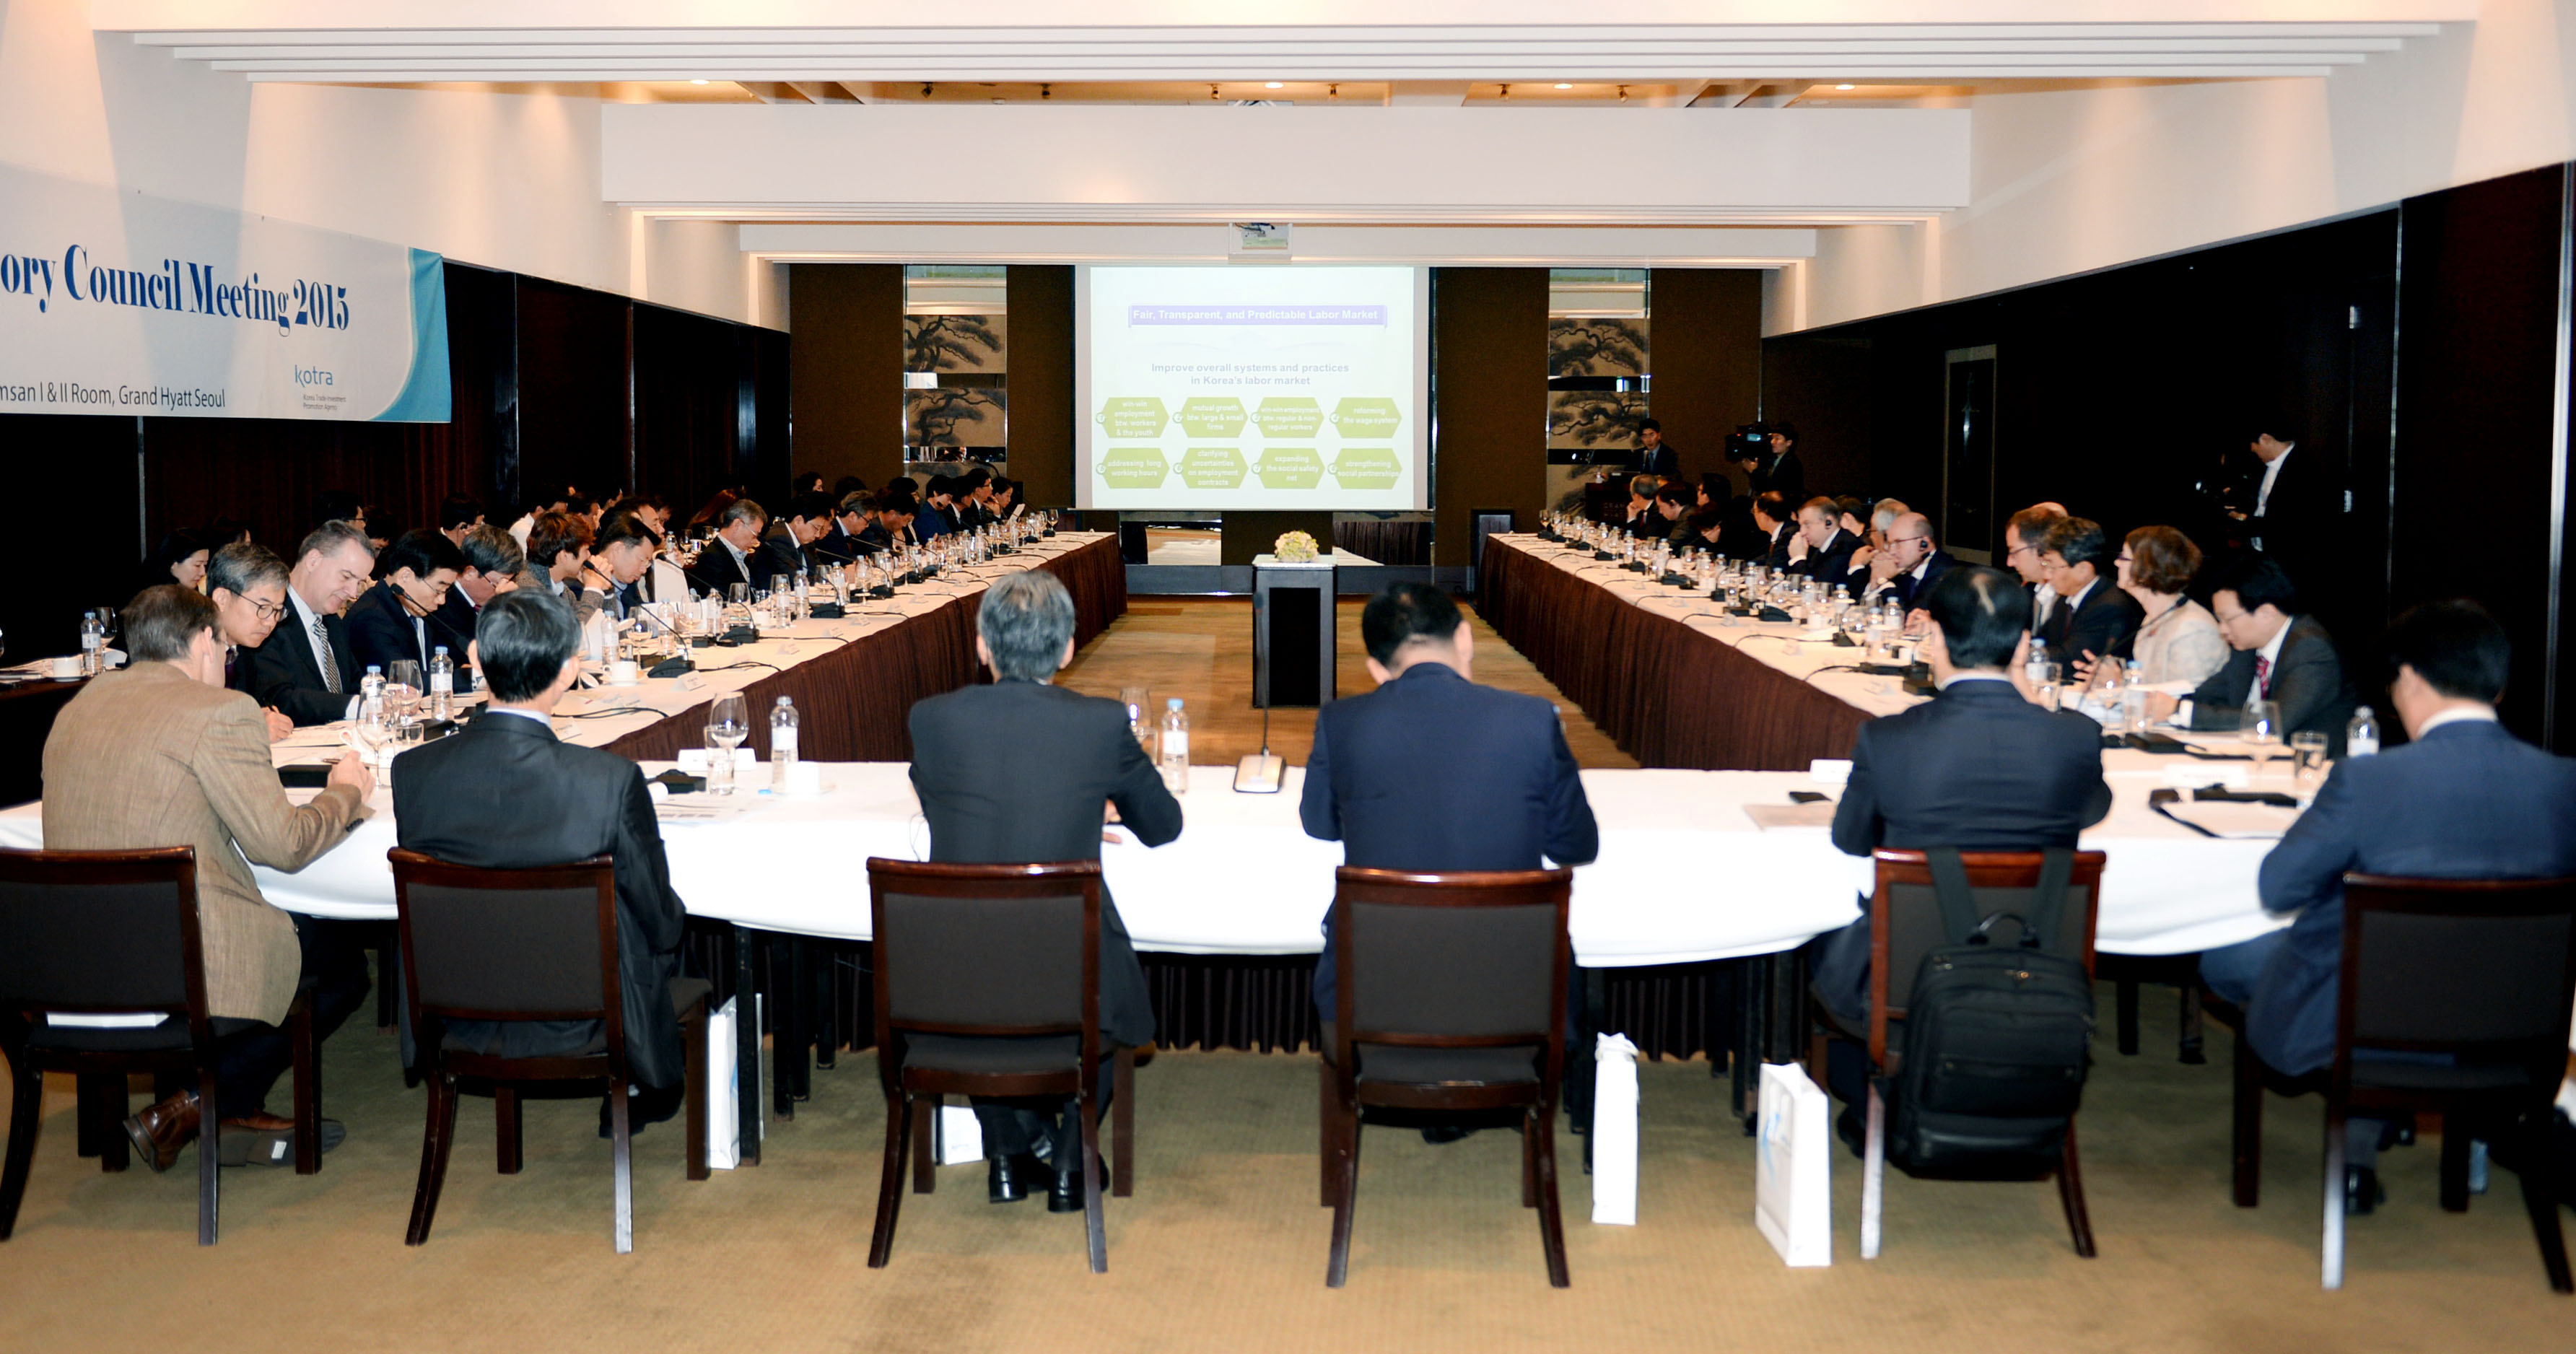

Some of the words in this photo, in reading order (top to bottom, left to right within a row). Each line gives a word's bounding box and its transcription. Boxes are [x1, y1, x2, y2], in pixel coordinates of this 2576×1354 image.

[1, 254, 57, 313] ory
[64, 244, 183, 311] Council
[186, 262, 290, 337] Meeting
[293, 279, 349, 330] 2015
[1133, 310, 1156, 320] Fair,
[1158, 310, 1223, 320] Transparent,
[1226, 310, 1245, 319] and
[1248, 310, 1306, 319] Predictable
[1309, 310, 1340, 319] Labor
[1342, 310, 1379, 319] Market
[1151, 363, 1194, 373] Improve
[1197, 363, 1231, 372] overall
[1234, 364, 1277, 374] systems
[1280, 363, 1298, 372] and
[1302, 363, 1349, 374] practices
[294, 364, 333, 388] kotra
[1190, 376, 1200, 385] in
[1203, 376, 1243, 385] Korea's
[1245, 376, 1271, 385] labor
[1275, 376, 1311, 385] market
[48, 382, 57, 403] &
[71, 383, 115, 407] Room,
[119, 385, 157, 405] Grand
[161, 387, 192, 411] Hyatt
[195, 388, 225, 407] Seoul
[1146, 459, 1161, 468] long
